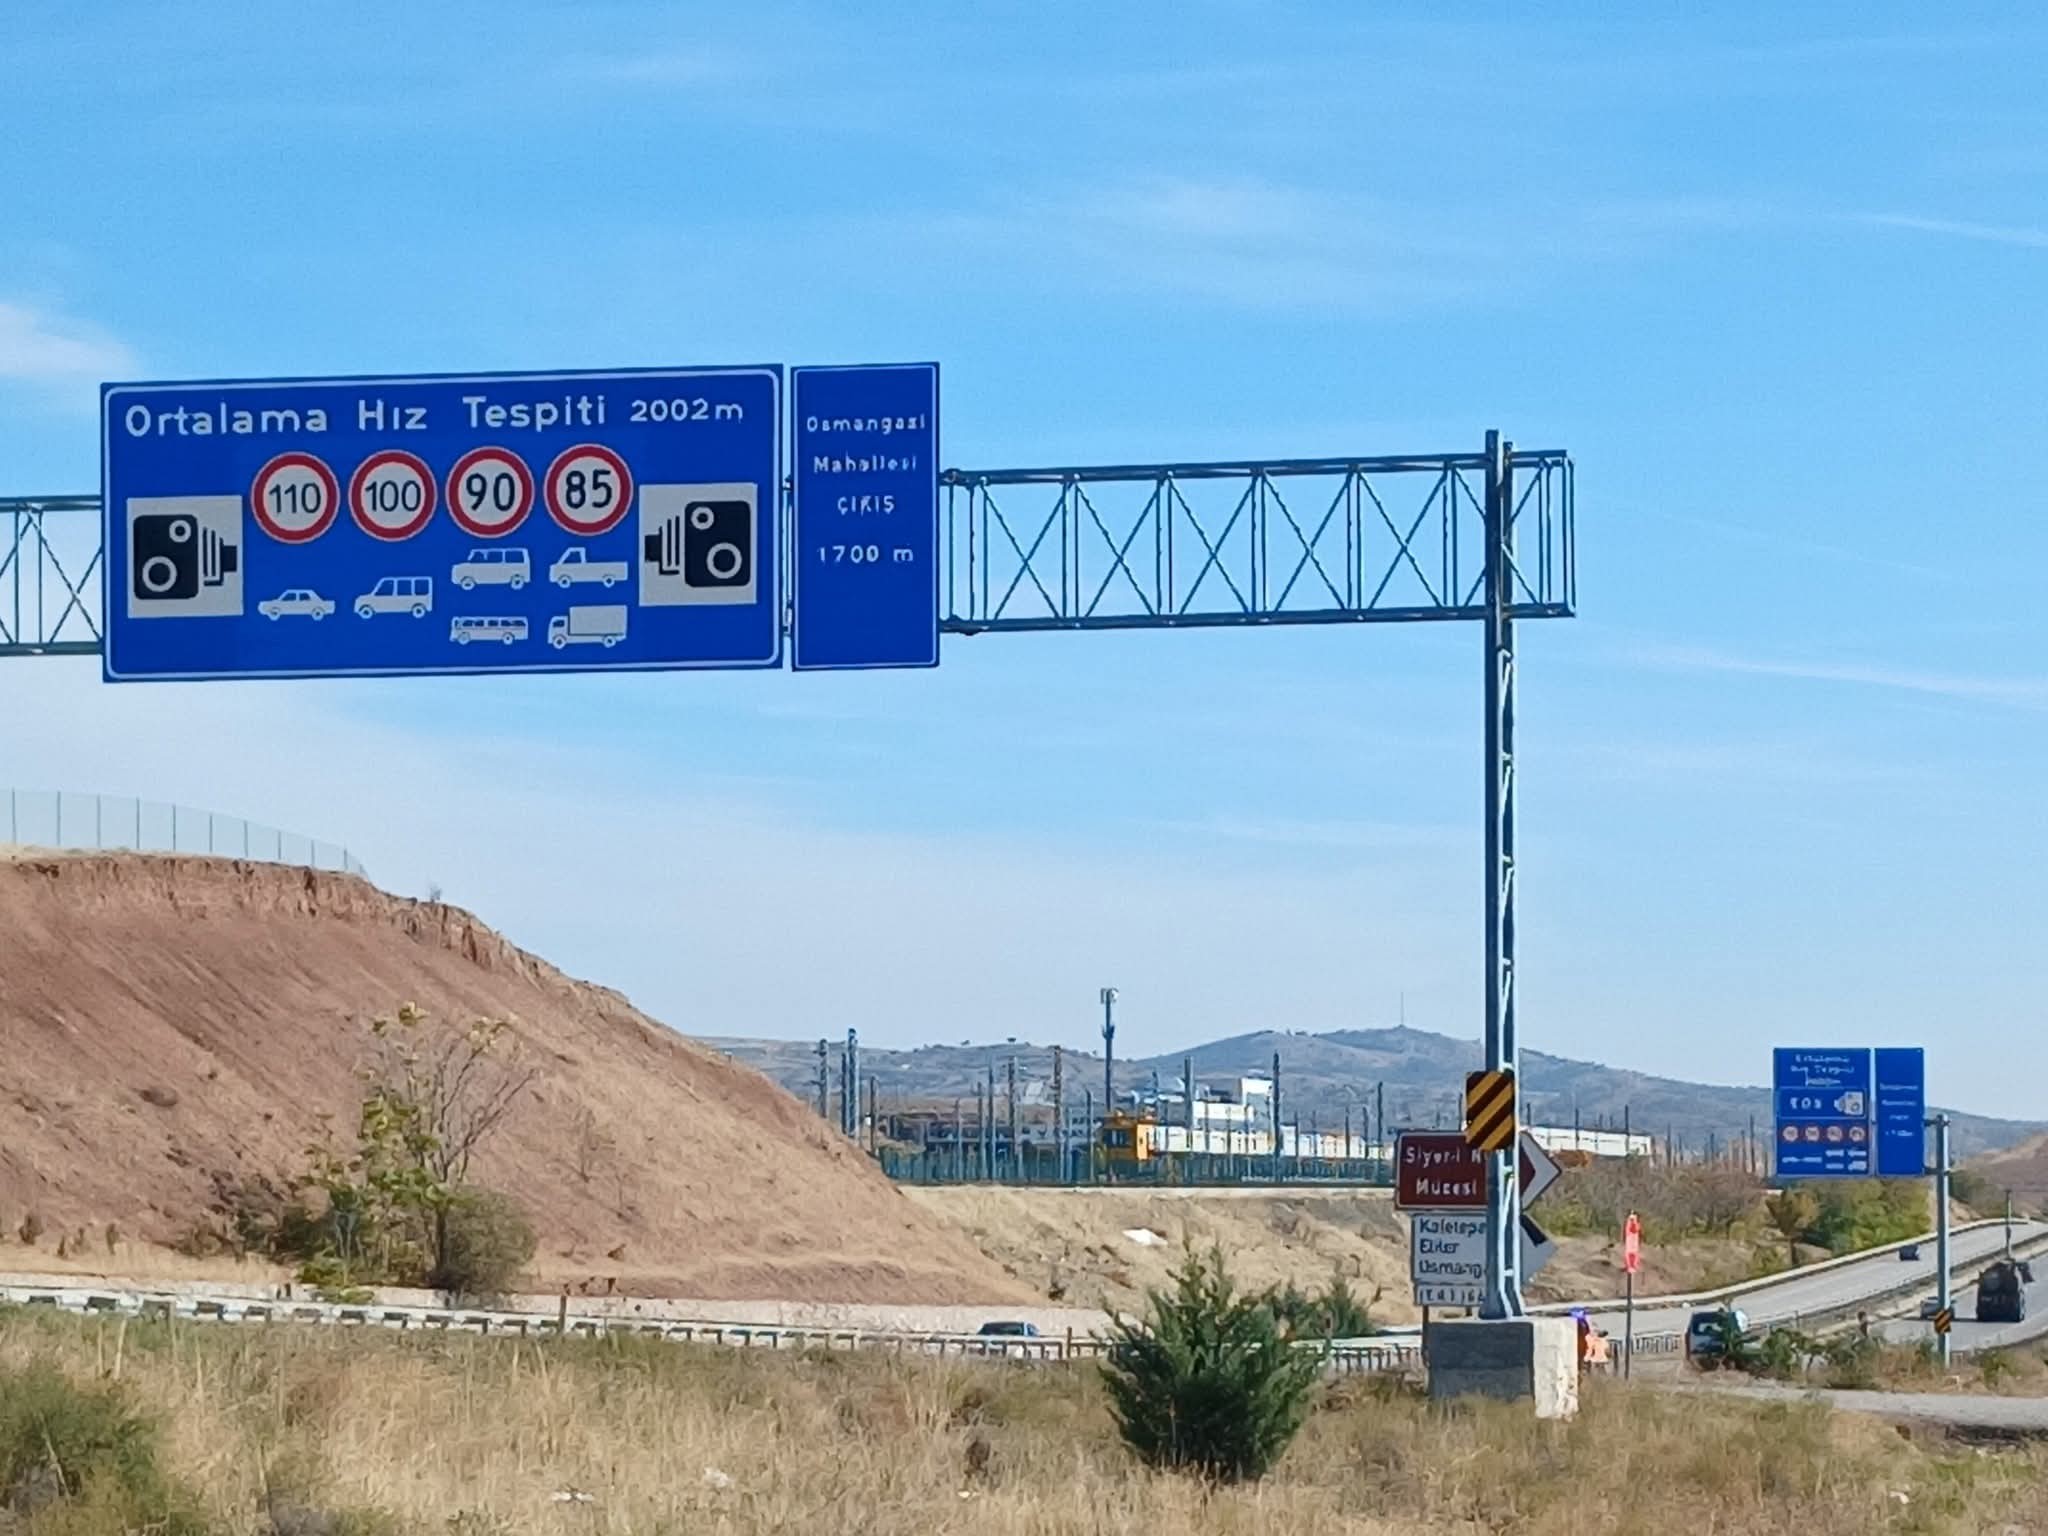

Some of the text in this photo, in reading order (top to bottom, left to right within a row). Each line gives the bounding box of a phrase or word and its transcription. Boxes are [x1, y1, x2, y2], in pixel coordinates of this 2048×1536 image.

[125, 402, 328, 436] Ortalama
[357, 399, 428, 430] Hız
[463, 395, 607, 430] Tespiti
[267, 483, 322, 515] 110
[363, 480, 422, 512] 100
[465, 473, 514, 511] 90
[564, 471, 614, 508] 85
[817, 544, 914, 564] 1700 m
